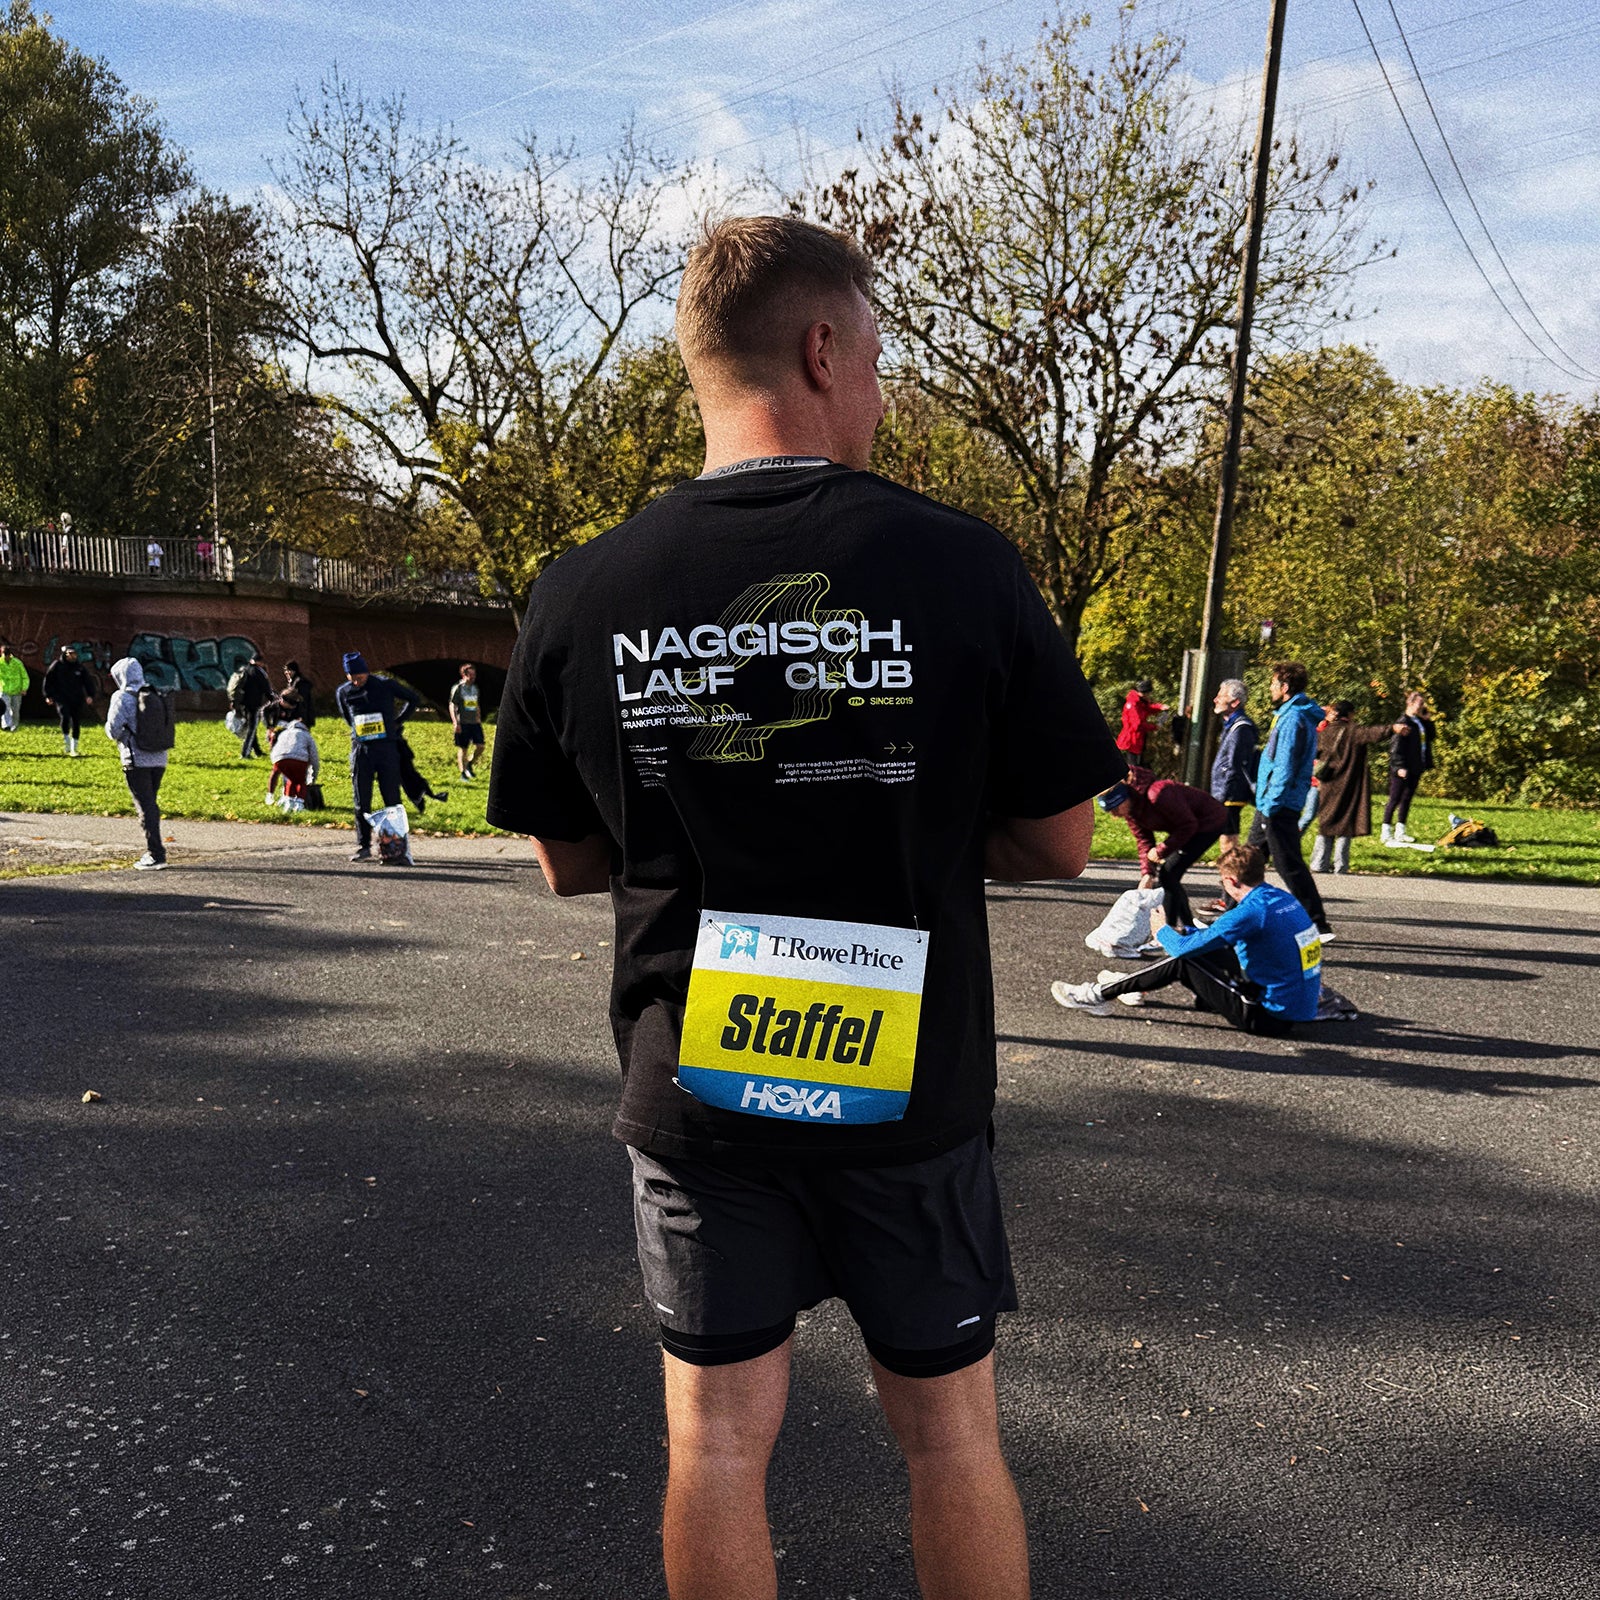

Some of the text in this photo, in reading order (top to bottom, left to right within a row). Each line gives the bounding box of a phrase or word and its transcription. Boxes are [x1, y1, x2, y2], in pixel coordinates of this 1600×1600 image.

[718, 457, 795, 476] NIKE PRO
[612, 619, 913, 666] NAGGISCH.
[616, 660, 913, 702] LAUF CLUB
[631, 704, 689, 717] NAGGISCH.DE
[870, 697, 894, 706] SINCE
[895, 697, 913, 705] 2019
[622, 713, 752, 729] FRANKFURT ORIGINAL APPARELL
[823, 774, 841, 782] check
[720, 994, 885, 1067] Staffel
[741, 1080, 842, 1119] HOKA
